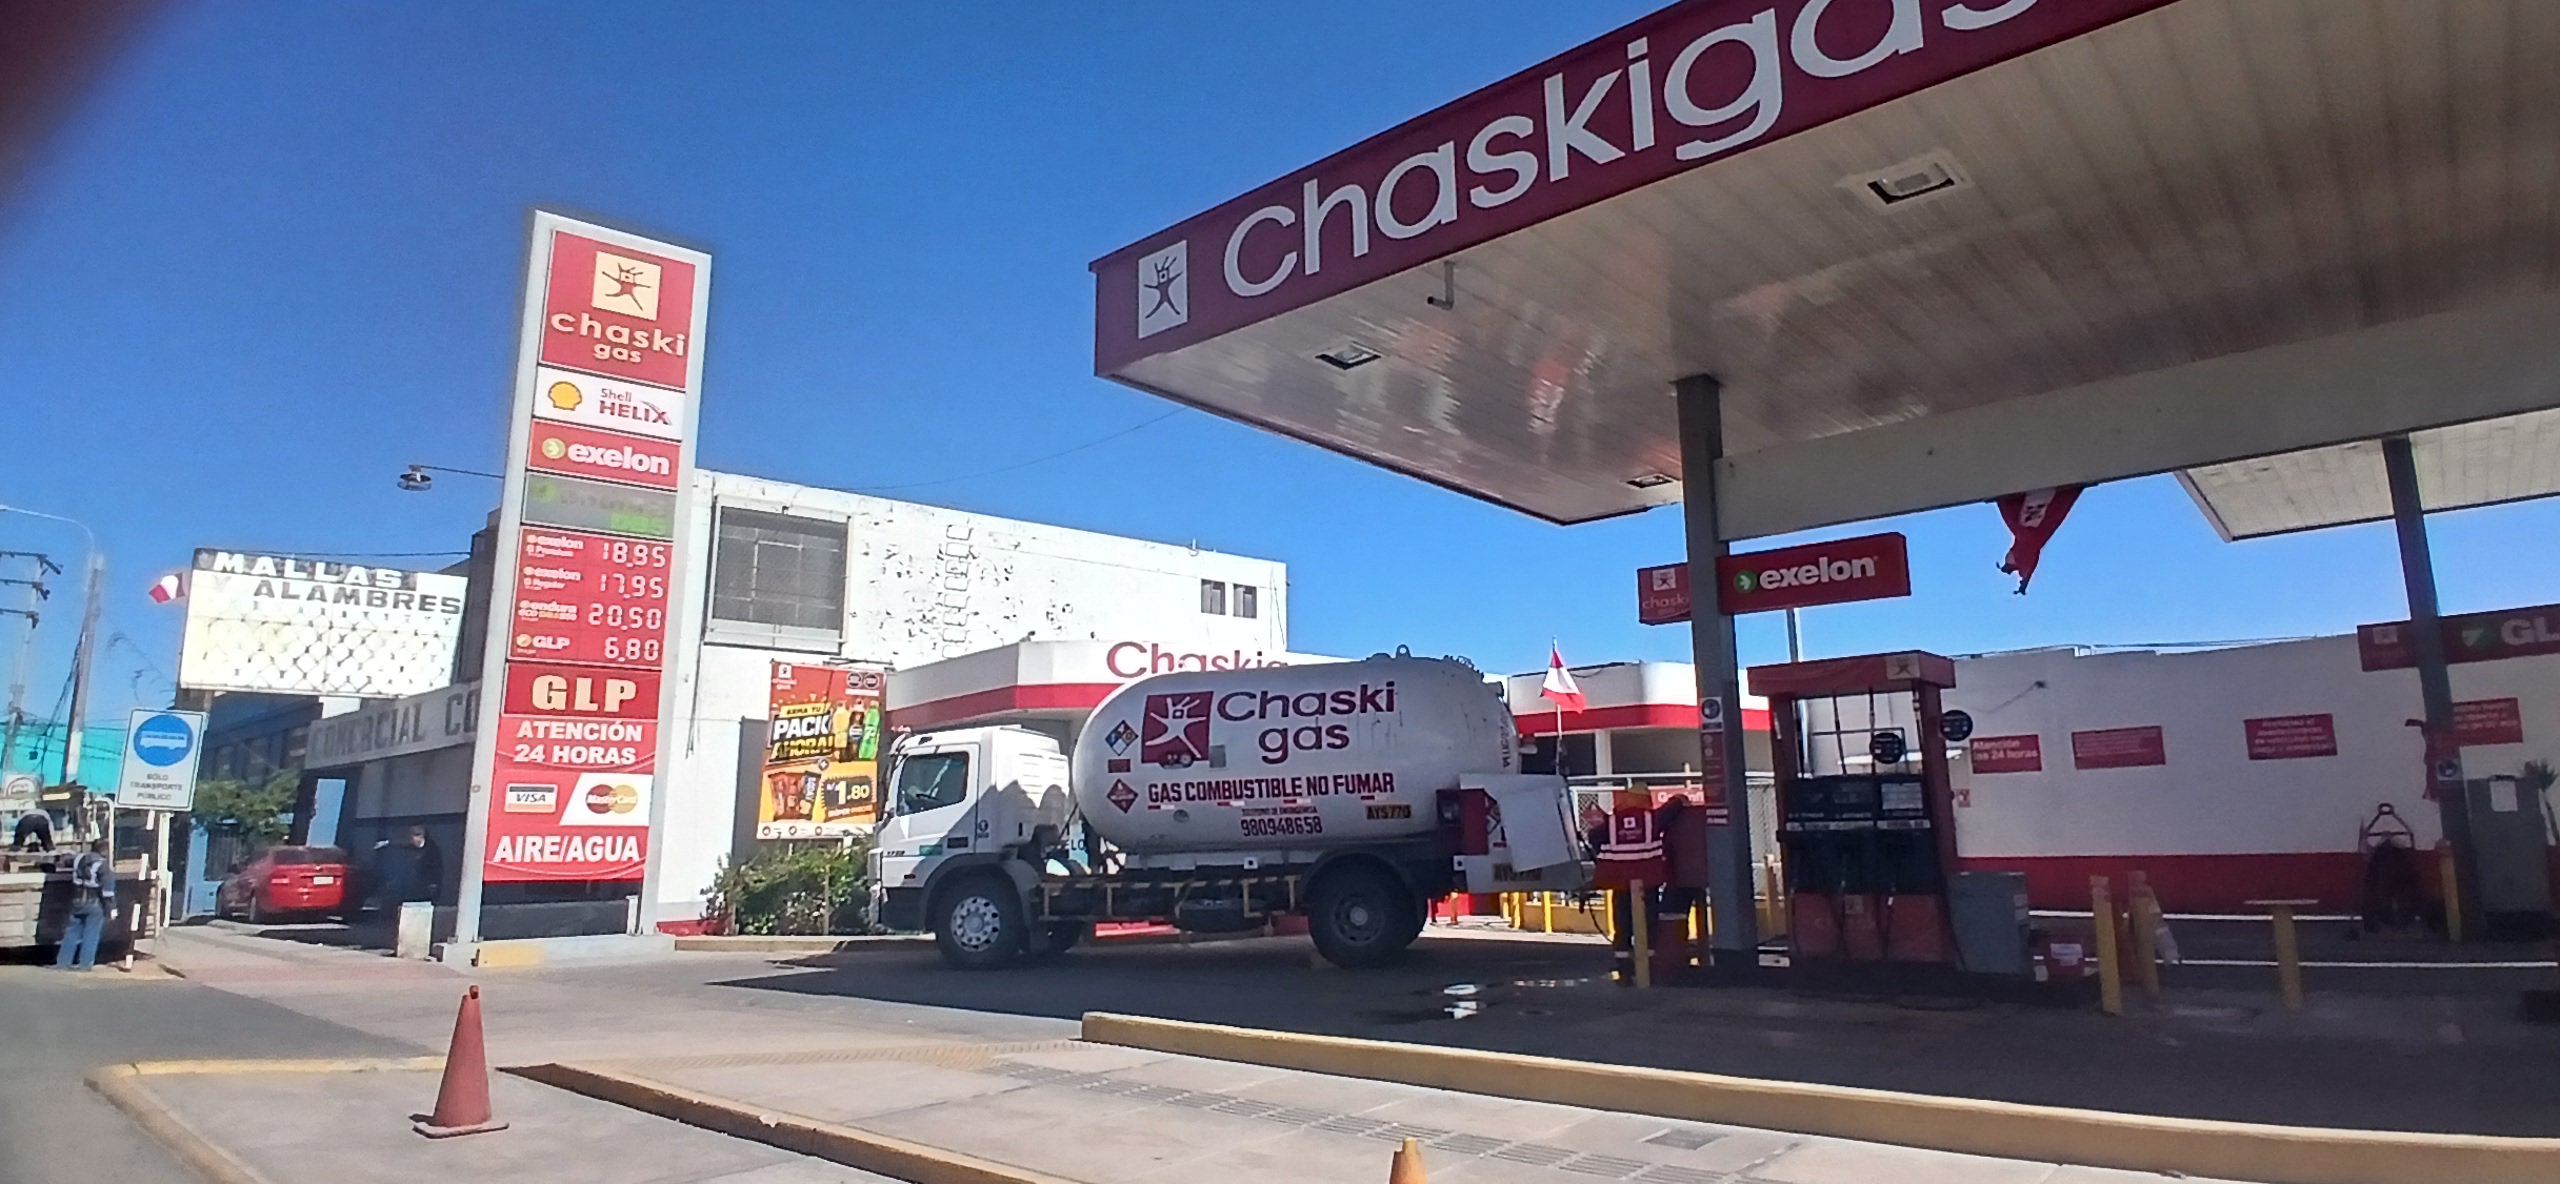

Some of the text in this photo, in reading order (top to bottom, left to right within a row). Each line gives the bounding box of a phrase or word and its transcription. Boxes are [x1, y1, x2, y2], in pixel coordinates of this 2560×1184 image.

[551, 313, 685, 357] chaski
[593, 342, 642, 363] gas
[600, 388, 632, 402] Shell
[599, 400, 670, 424] HELIX
[567, 442, 670, 475] exelon
[212, 551, 403, 589] MALLAS
[1758, 555, 1876, 590] exelon
[253, 579, 461, 615] ALAMBRES
[533, 635, 571, 650] GLP
[531, 675, 637, 713] GLP
[1217, 681, 1395, 721] Chaski
[309, 703, 427, 760] COMERCIAL
[517, 720, 643, 742] ATENCIÓN
[773, 714, 830, 740] PACK
[514, 744, 637, 765] 24 HORAS
[770, 736, 834, 760] AHORA!
[1259, 724, 1350, 765] gas
[1973, 739, 2020, 750] Atención
[1991, 750, 2005, 759] 24
[2006, 749, 2038, 758] horas
[130, 782, 183, 791] TRANSPORTE
[516, 793, 546, 803] VISA
[1148, 772, 1395, 803] GAS COMBUSTIBLE NO FUMAR
[1241, 816, 1323, 836] 980948658
[493, 835, 641, 863] AIRE/AGUA
